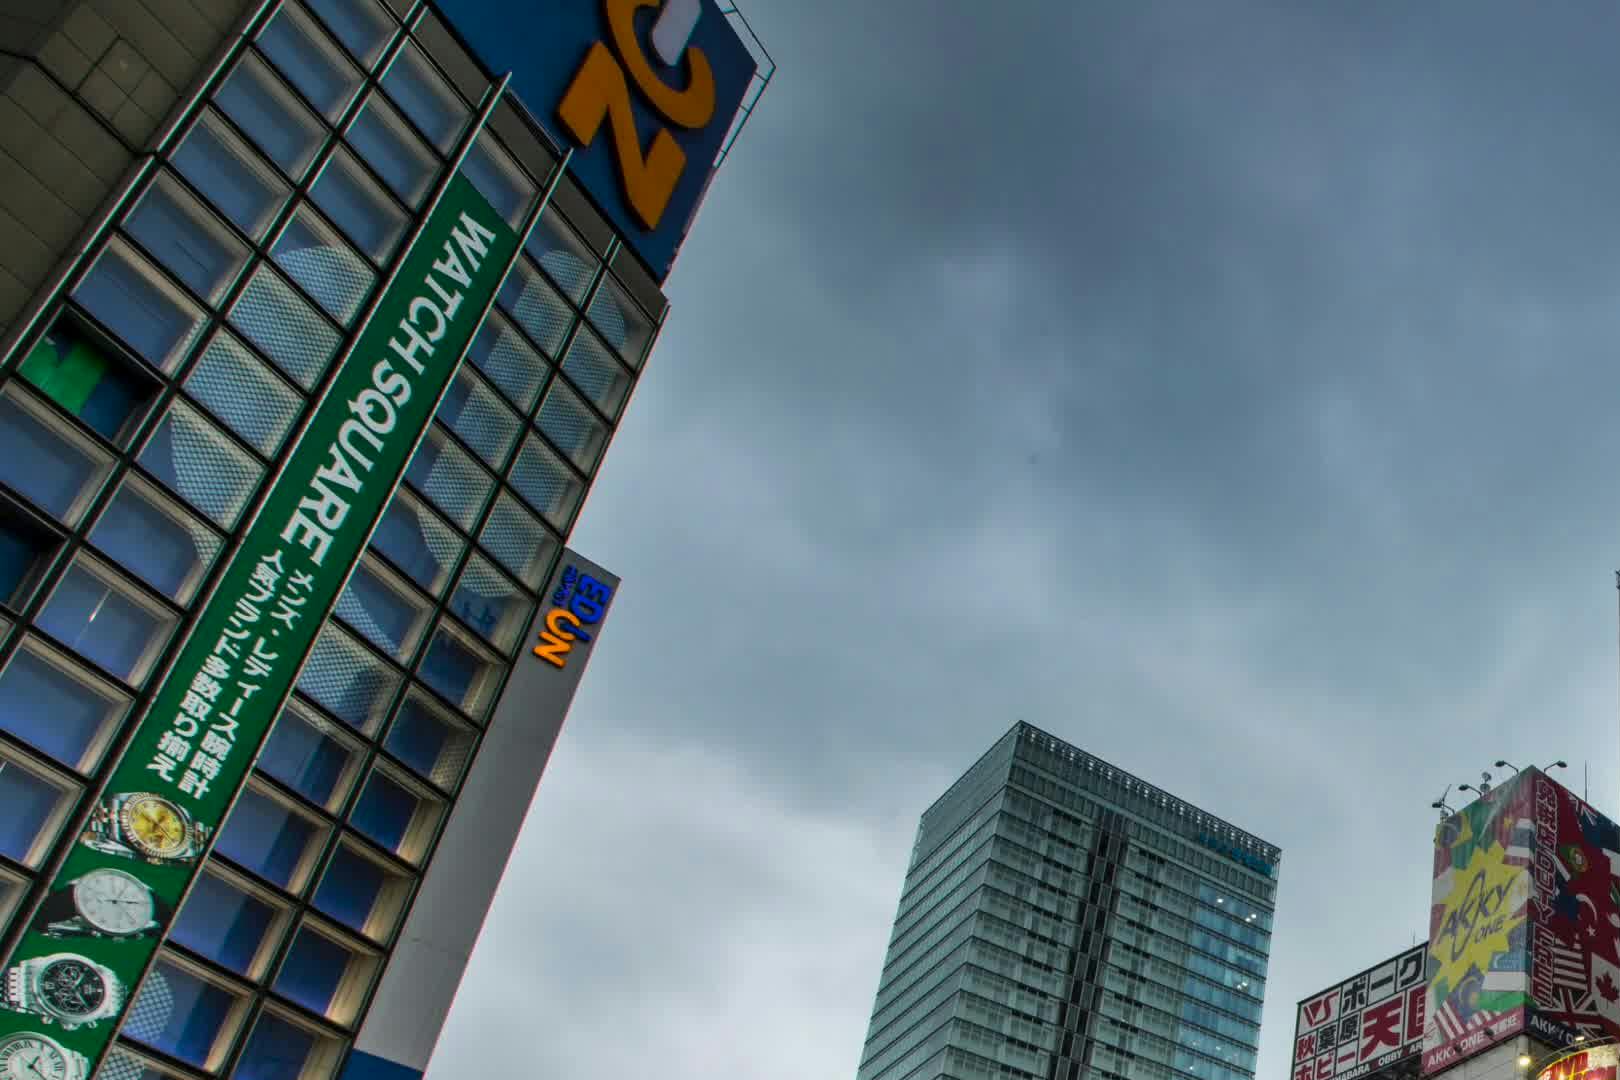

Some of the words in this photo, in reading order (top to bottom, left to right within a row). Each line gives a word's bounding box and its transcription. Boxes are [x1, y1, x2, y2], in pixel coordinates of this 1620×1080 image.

[389, 211, 497, 395] WATCH
[280, 363, 414, 568] SQUARE
[1297, 1015, 1358, 1061] 秋葉原
